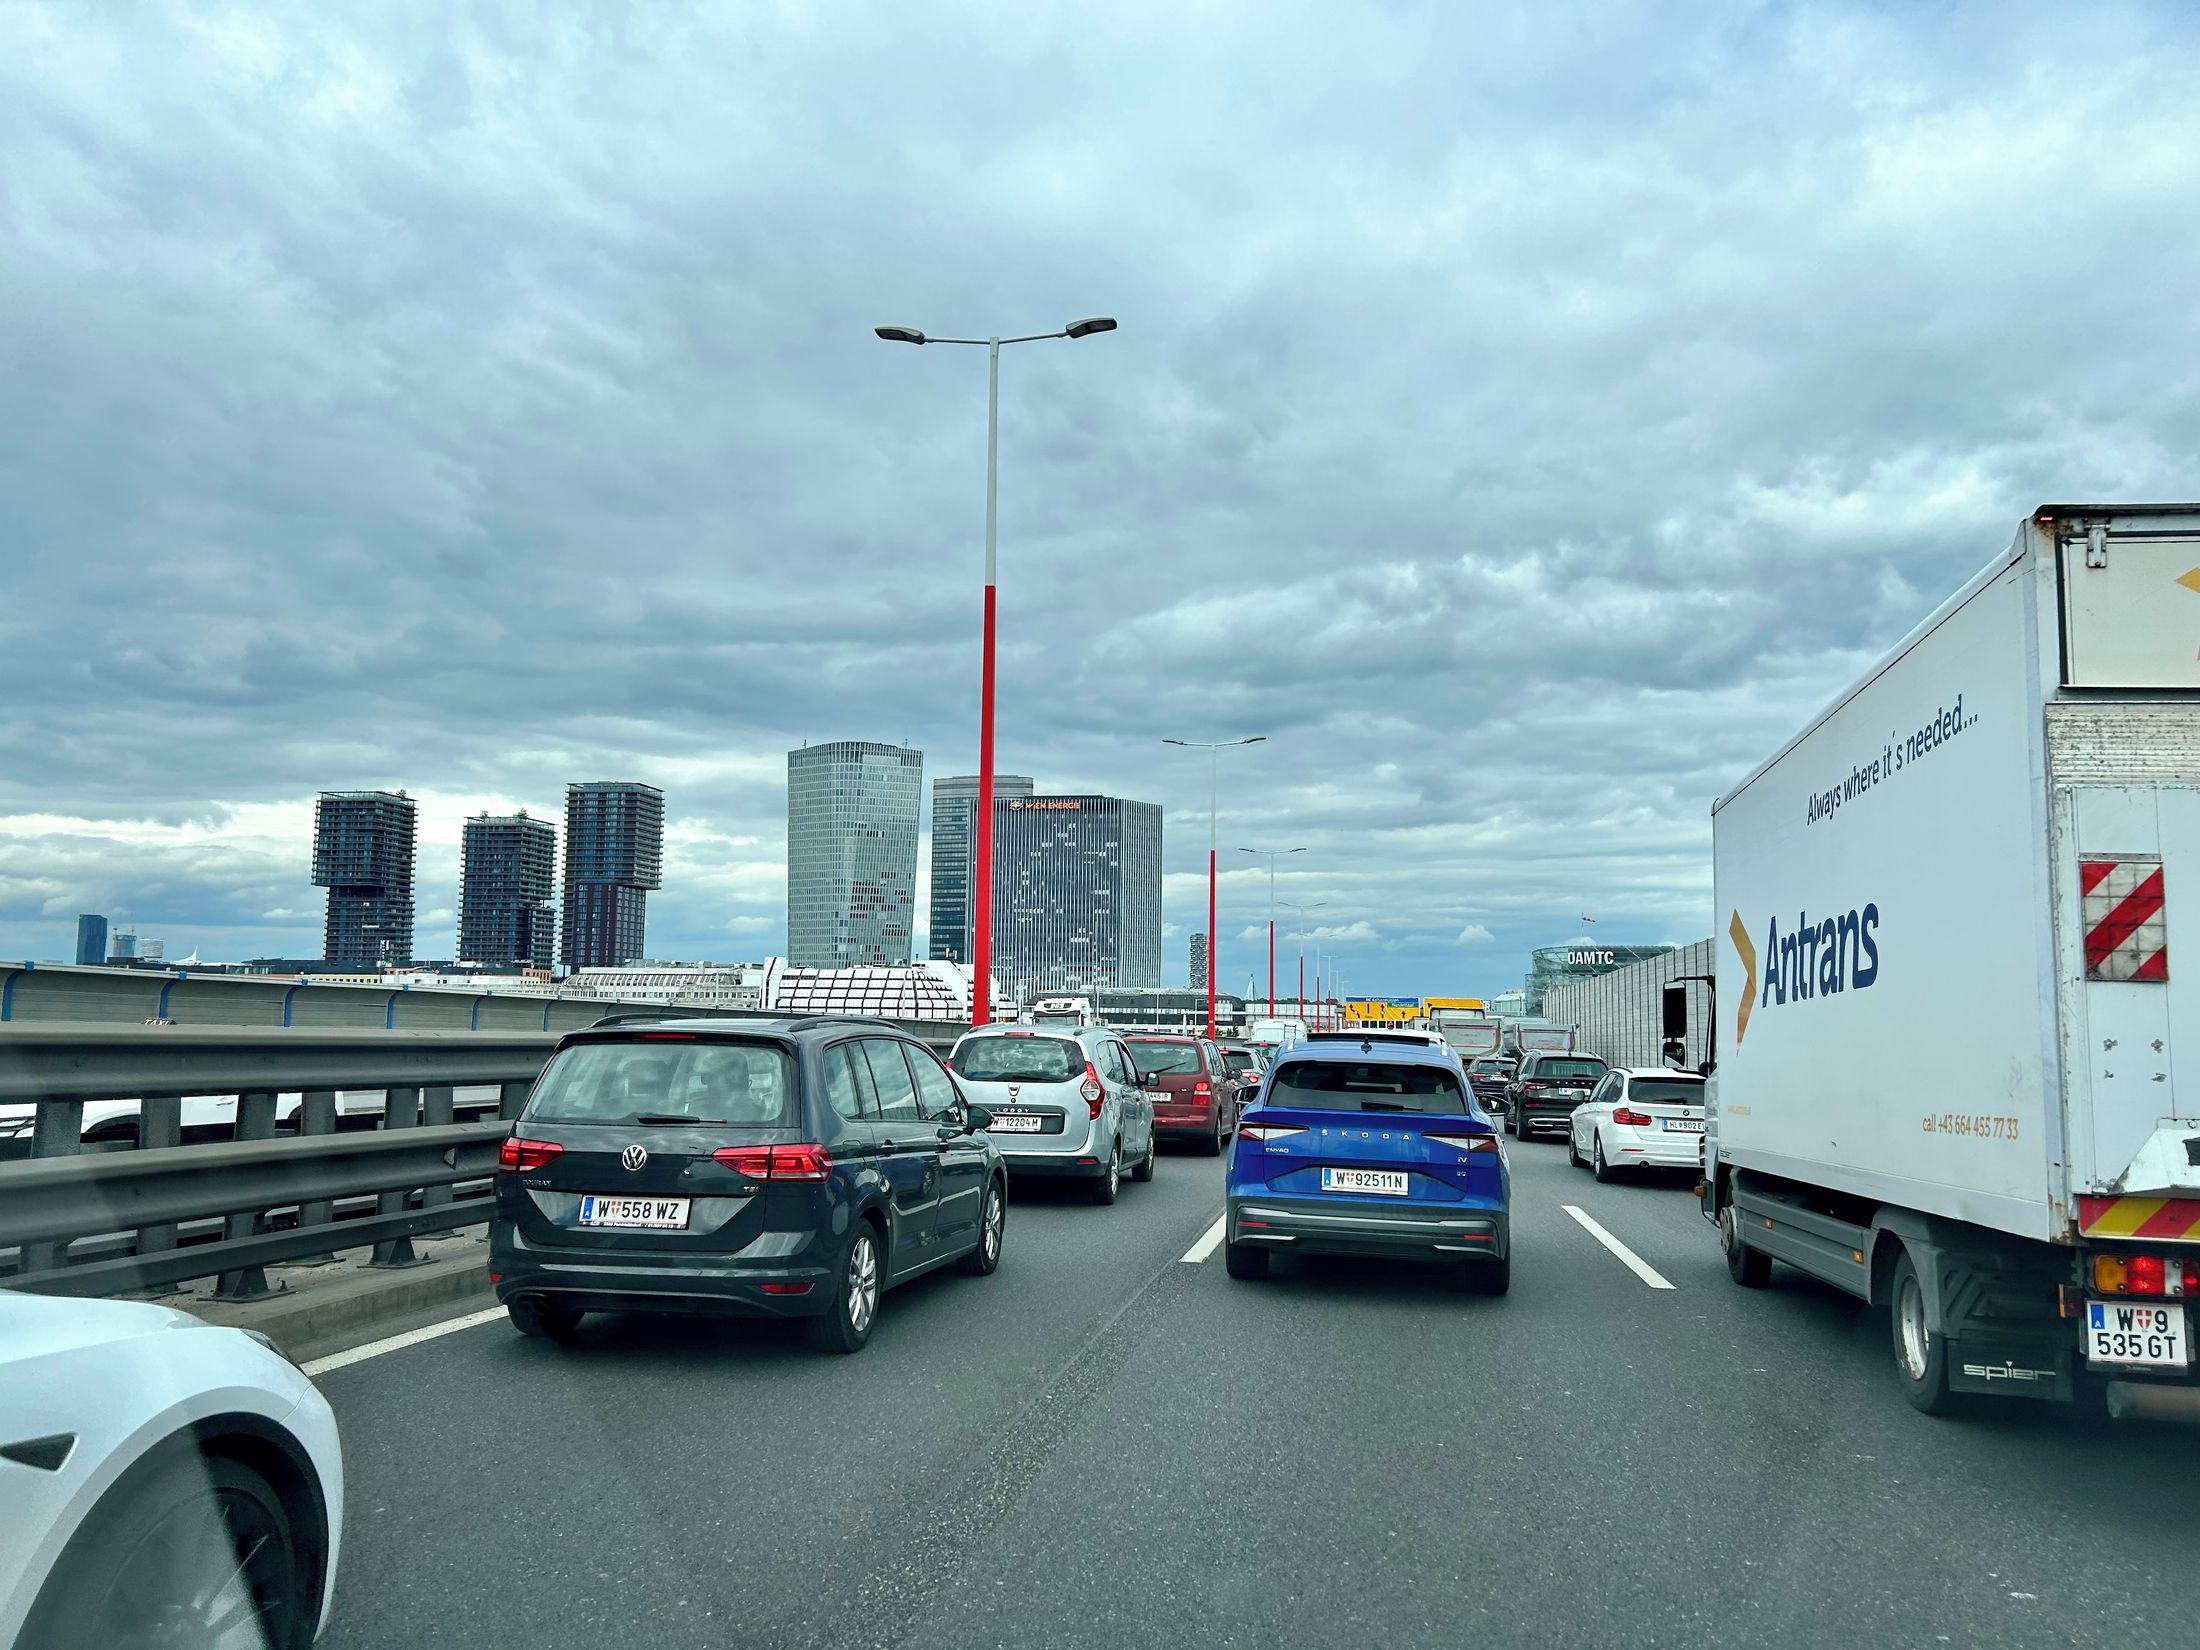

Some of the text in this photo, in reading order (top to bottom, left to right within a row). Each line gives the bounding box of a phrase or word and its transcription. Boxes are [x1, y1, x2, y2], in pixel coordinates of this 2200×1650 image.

[1807, 784, 1841, 826] Always
[1844, 765, 1880, 802] where
[1906, 693, 1978, 764] needed...
[1048, 802, 1081, 810] ENERGIE
[1762, 902, 1879, 1009] Antrans
[1922, 1113, 2019, 1140] call +43 664 455 77 33
[1336, 1171, 1345, 1185] W
[598, 1200, 610, 1218] W
[621, 1201, 652, 1219] 558
[656, 1202, 679, 1220] WZ
[2117, 1308, 2134, 1332] W
[2154, 1310, 2168, 1334] 9
[2097, 1333, 2177, 1359] 535 GT
[1963, 1360, 2057, 1381] spier
